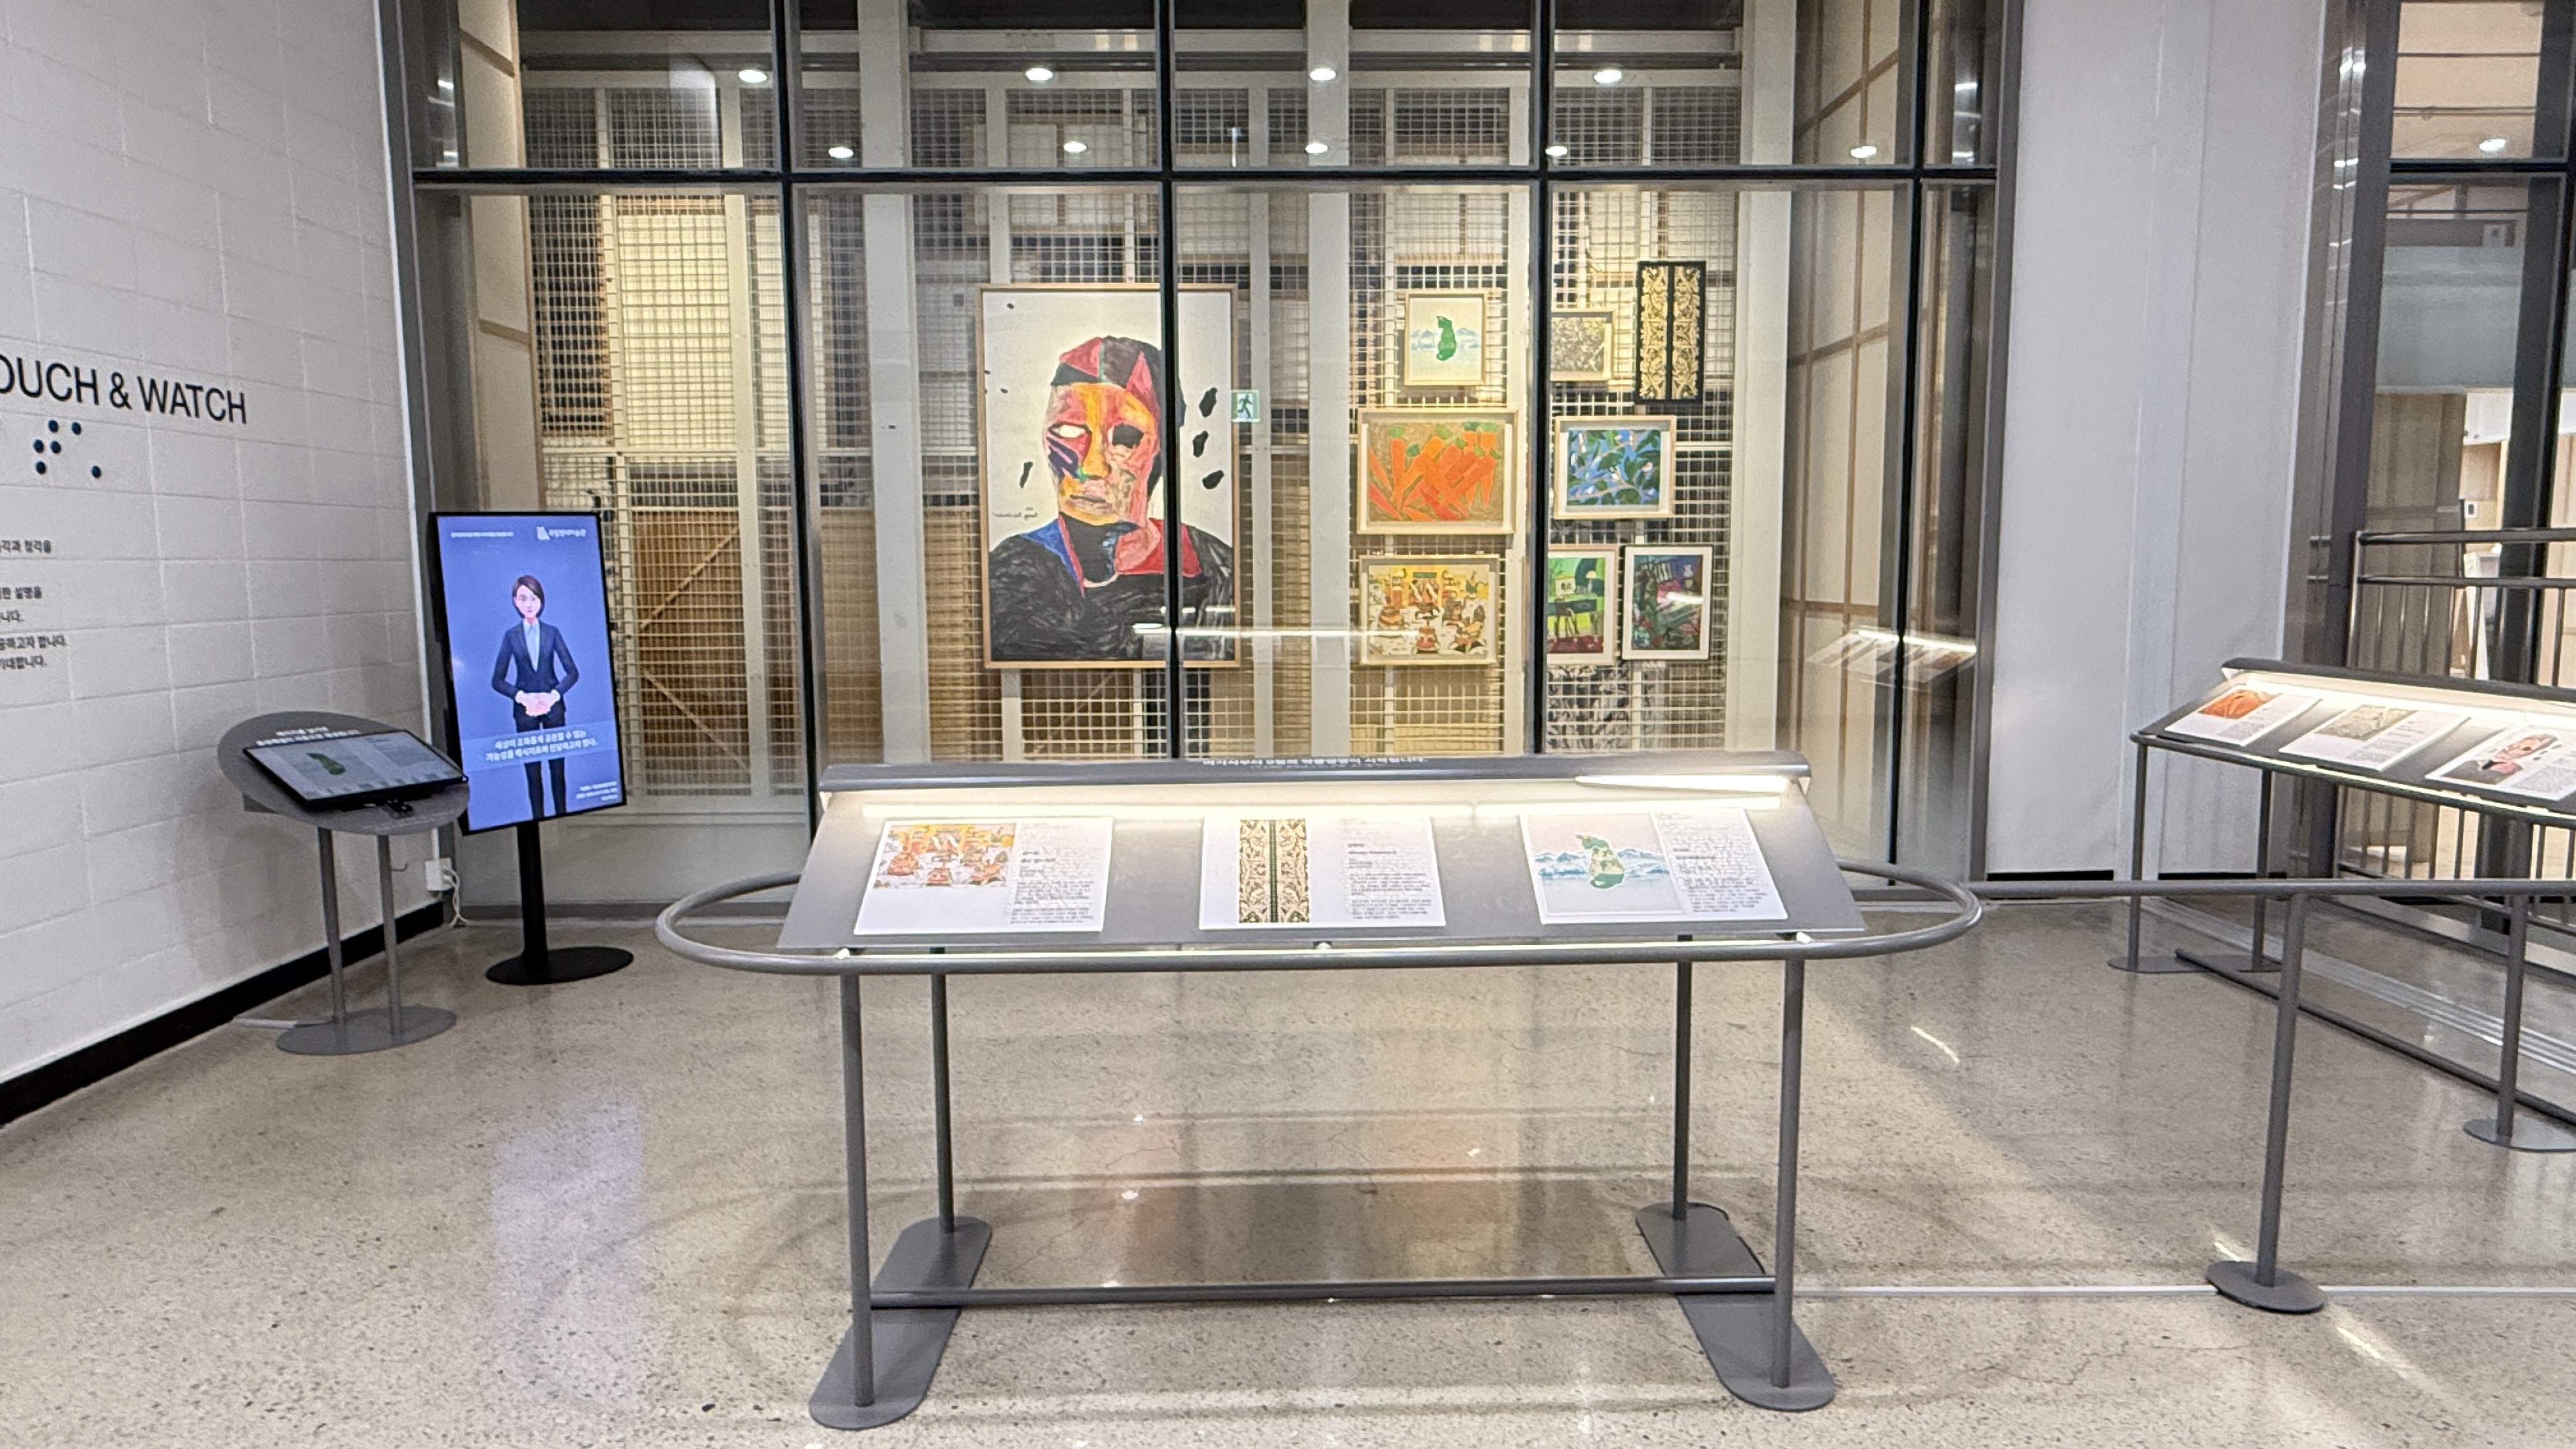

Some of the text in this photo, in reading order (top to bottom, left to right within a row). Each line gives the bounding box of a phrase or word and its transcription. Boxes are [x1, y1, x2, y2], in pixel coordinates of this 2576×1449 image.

[110, 371, 132, 410] &
[137, 376, 247, 424] WATCH
[0, 540, 21, 553] 각과
